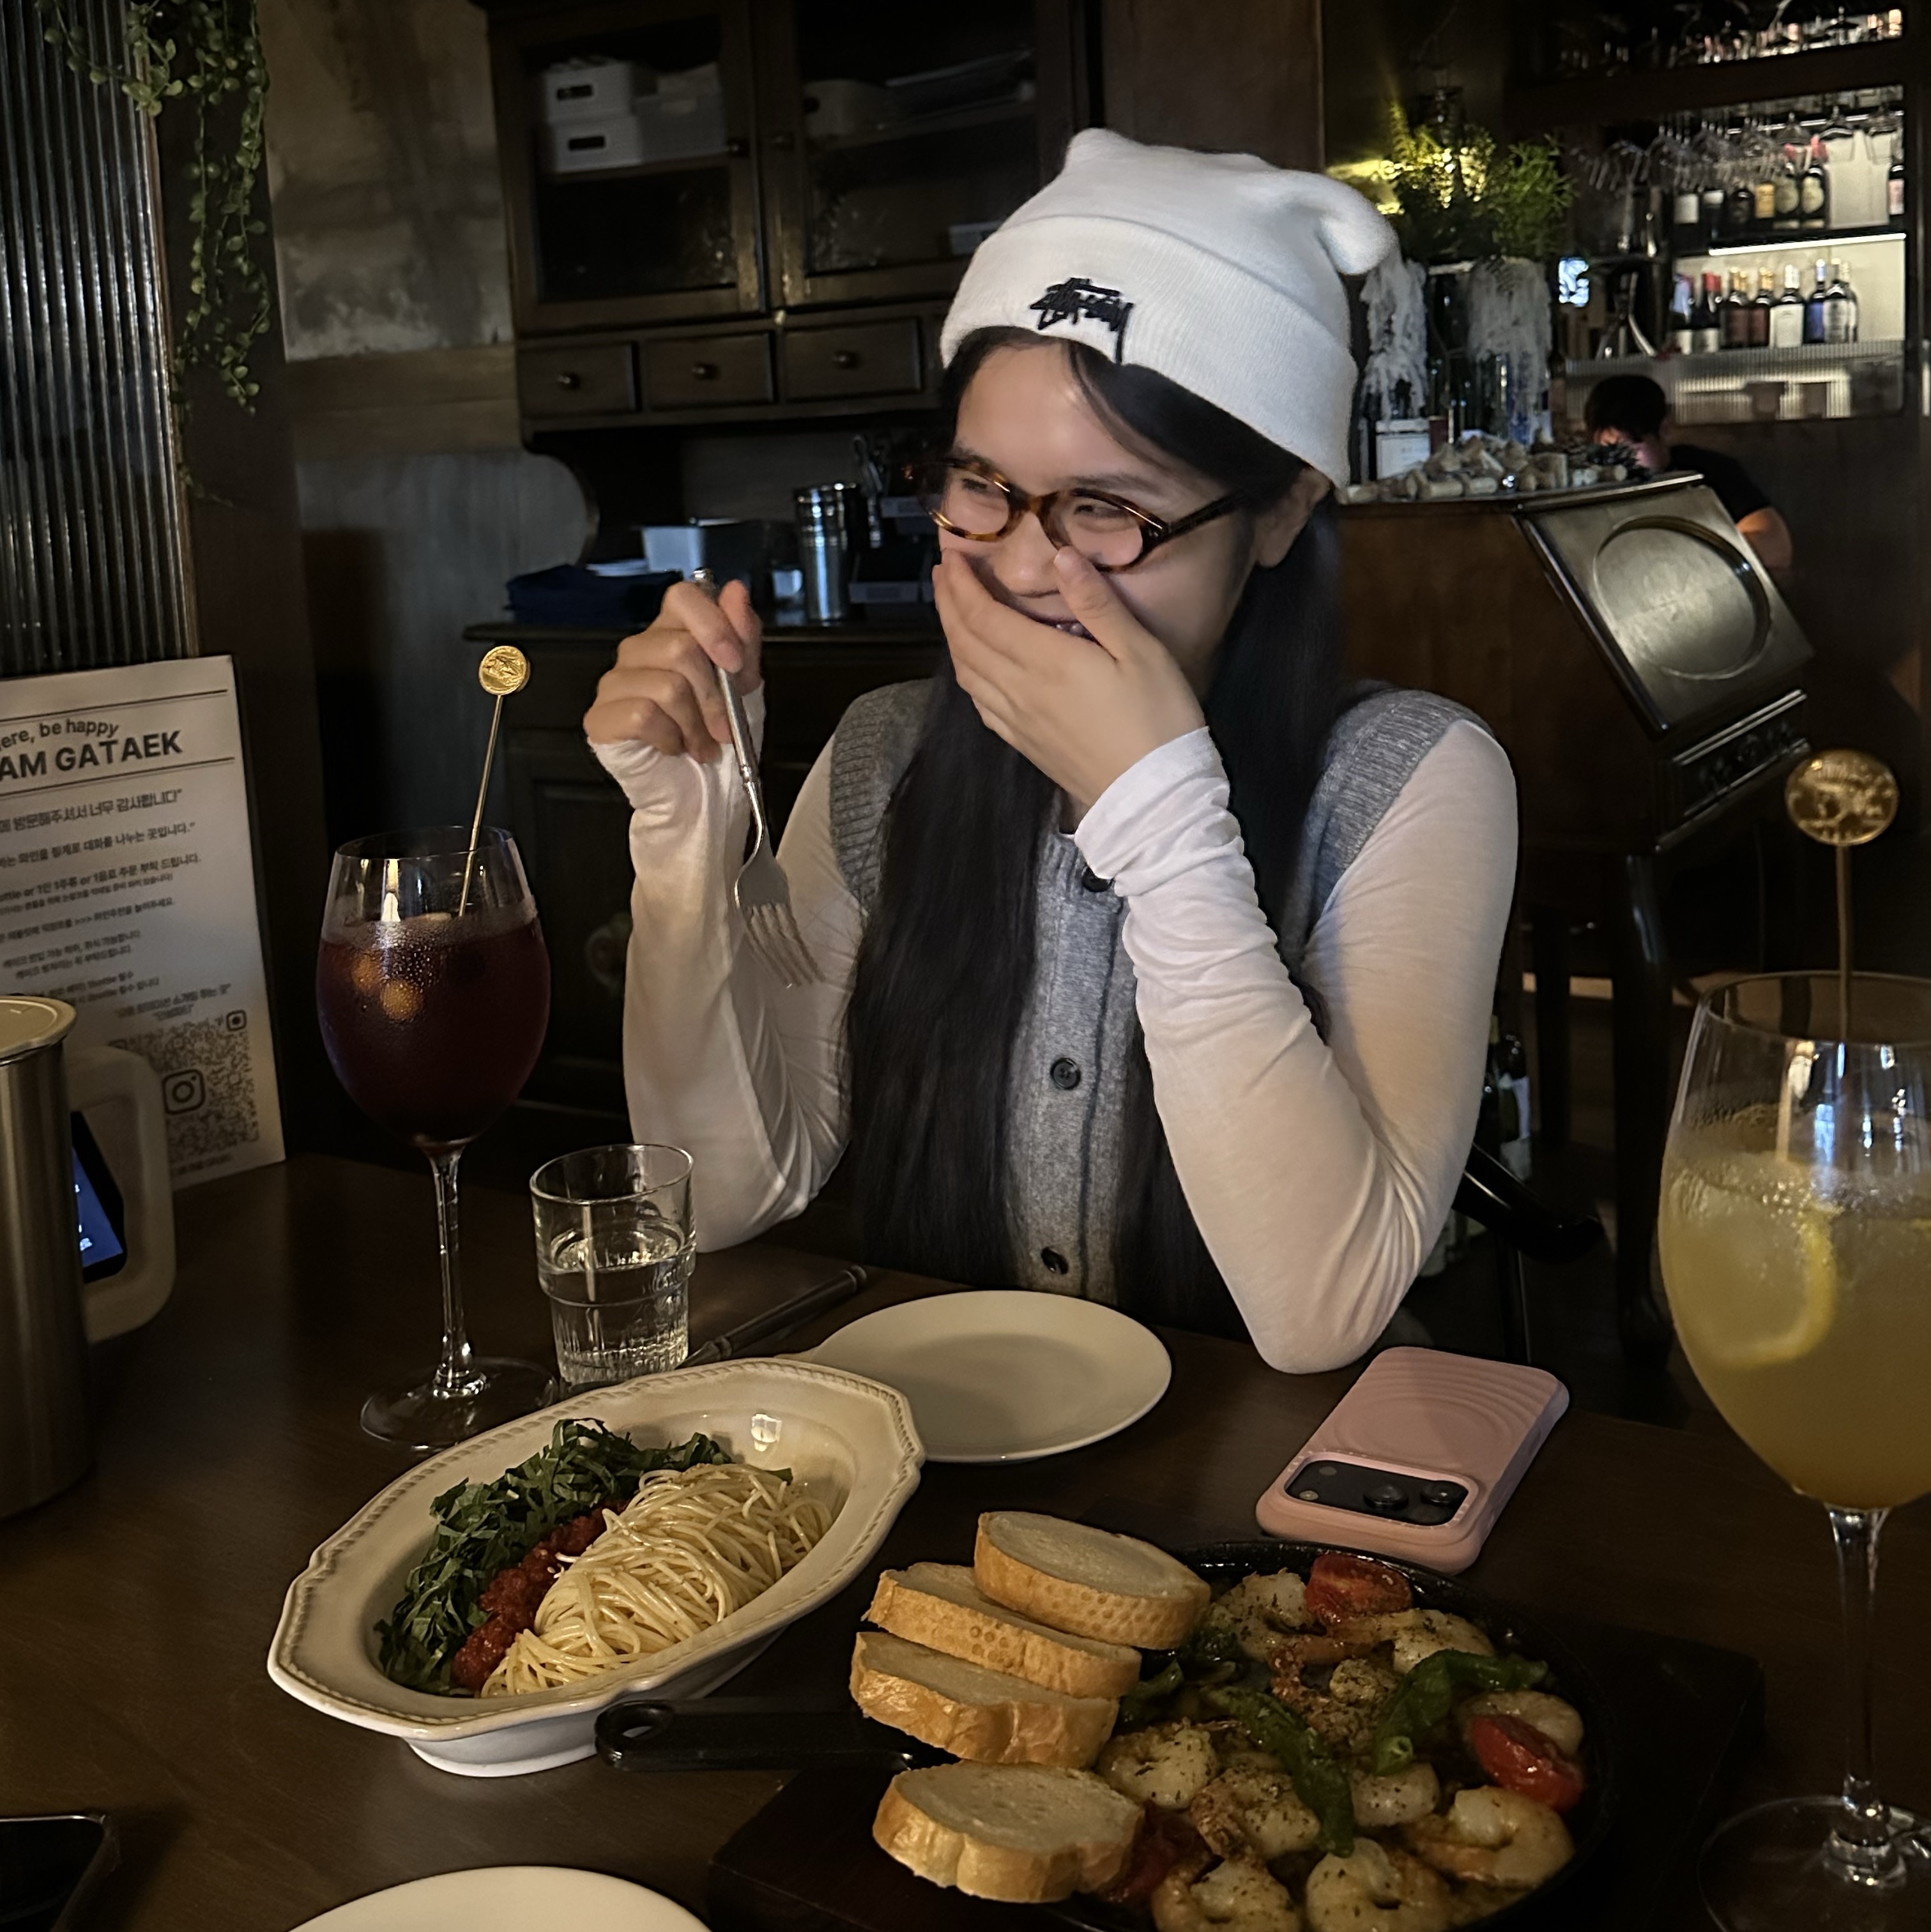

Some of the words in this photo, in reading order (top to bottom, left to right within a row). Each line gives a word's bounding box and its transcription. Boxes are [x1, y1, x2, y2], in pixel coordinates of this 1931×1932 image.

[0, 729, 35, 751] ere,
[39, 722, 62, 738] be
[66, 719, 120, 738] happy
[0, 751, 47, 783] AM
[55, 730, 183, 772] GATAEK
[89, 800, 114, 816] 너무
[116, 832, 145, 845] 나누는
